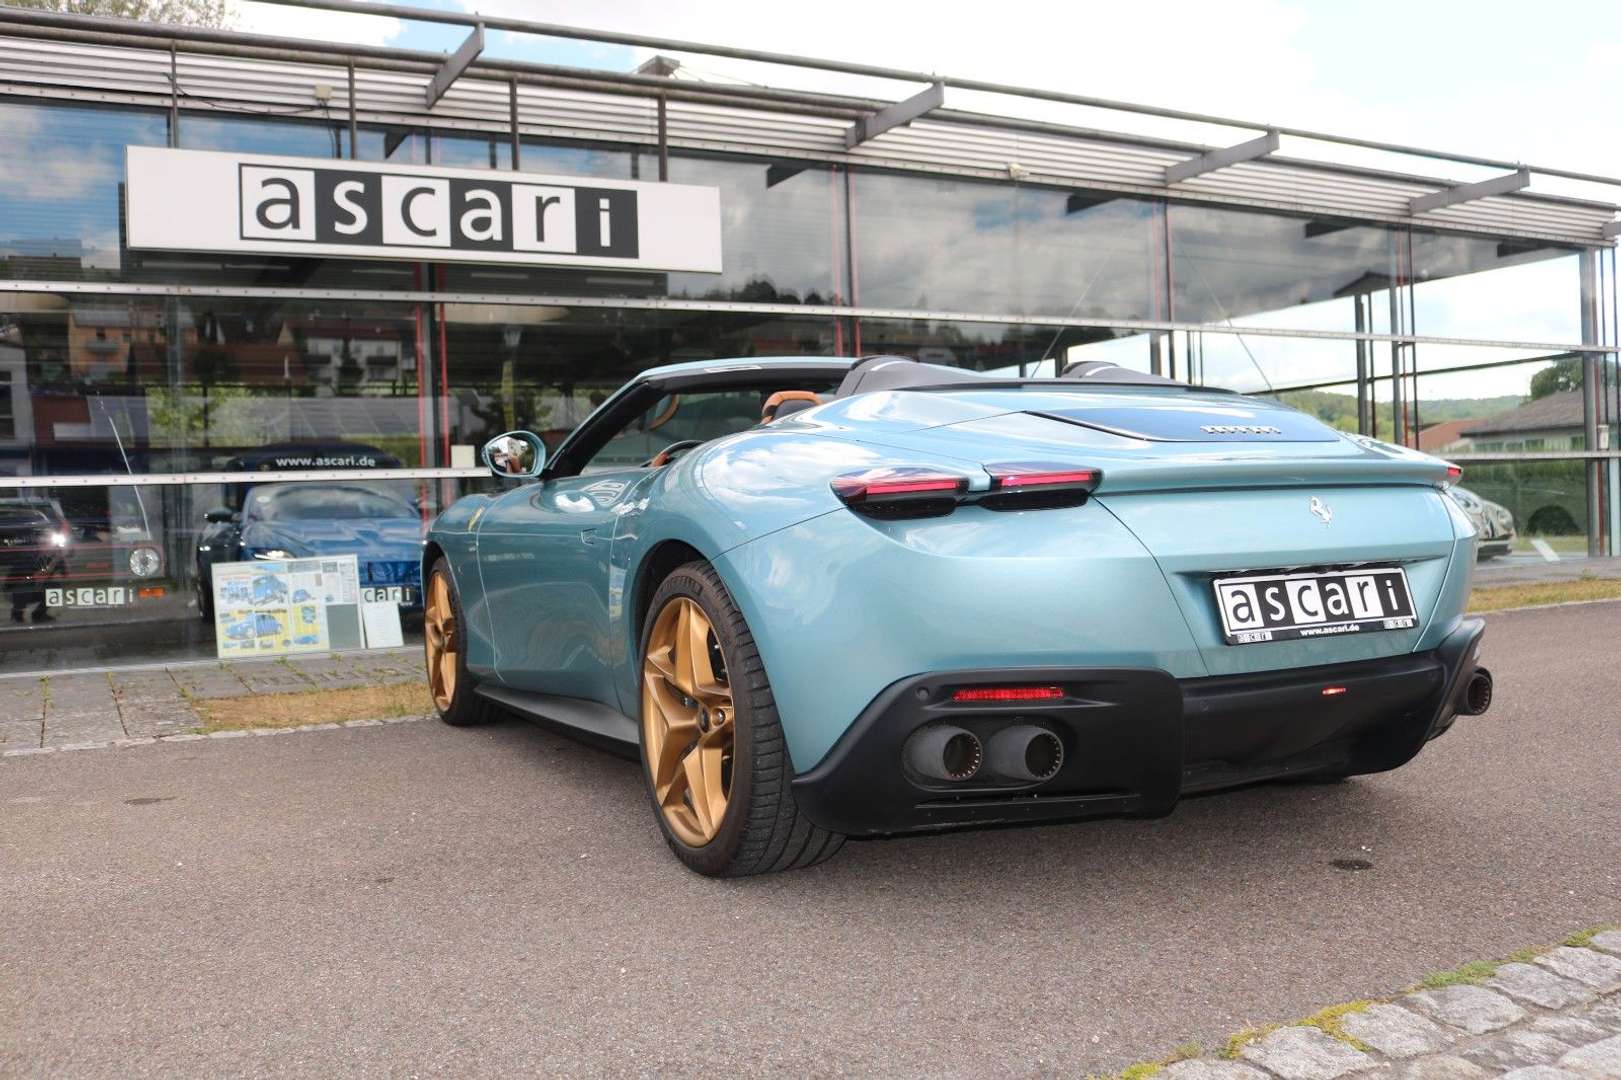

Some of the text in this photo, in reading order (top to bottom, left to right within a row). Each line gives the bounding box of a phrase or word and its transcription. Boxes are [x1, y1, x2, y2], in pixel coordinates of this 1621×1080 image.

[255, 177, 611, 248] ascari
[275, 455, 376, 467] www.ascari.de
[47, 588, 133, 605] ascari
[364, 588, 410, 603] cari
[1230, 579, 1399, 624] ascari
[1300, 624, 1360, 637] www.ascari.de
